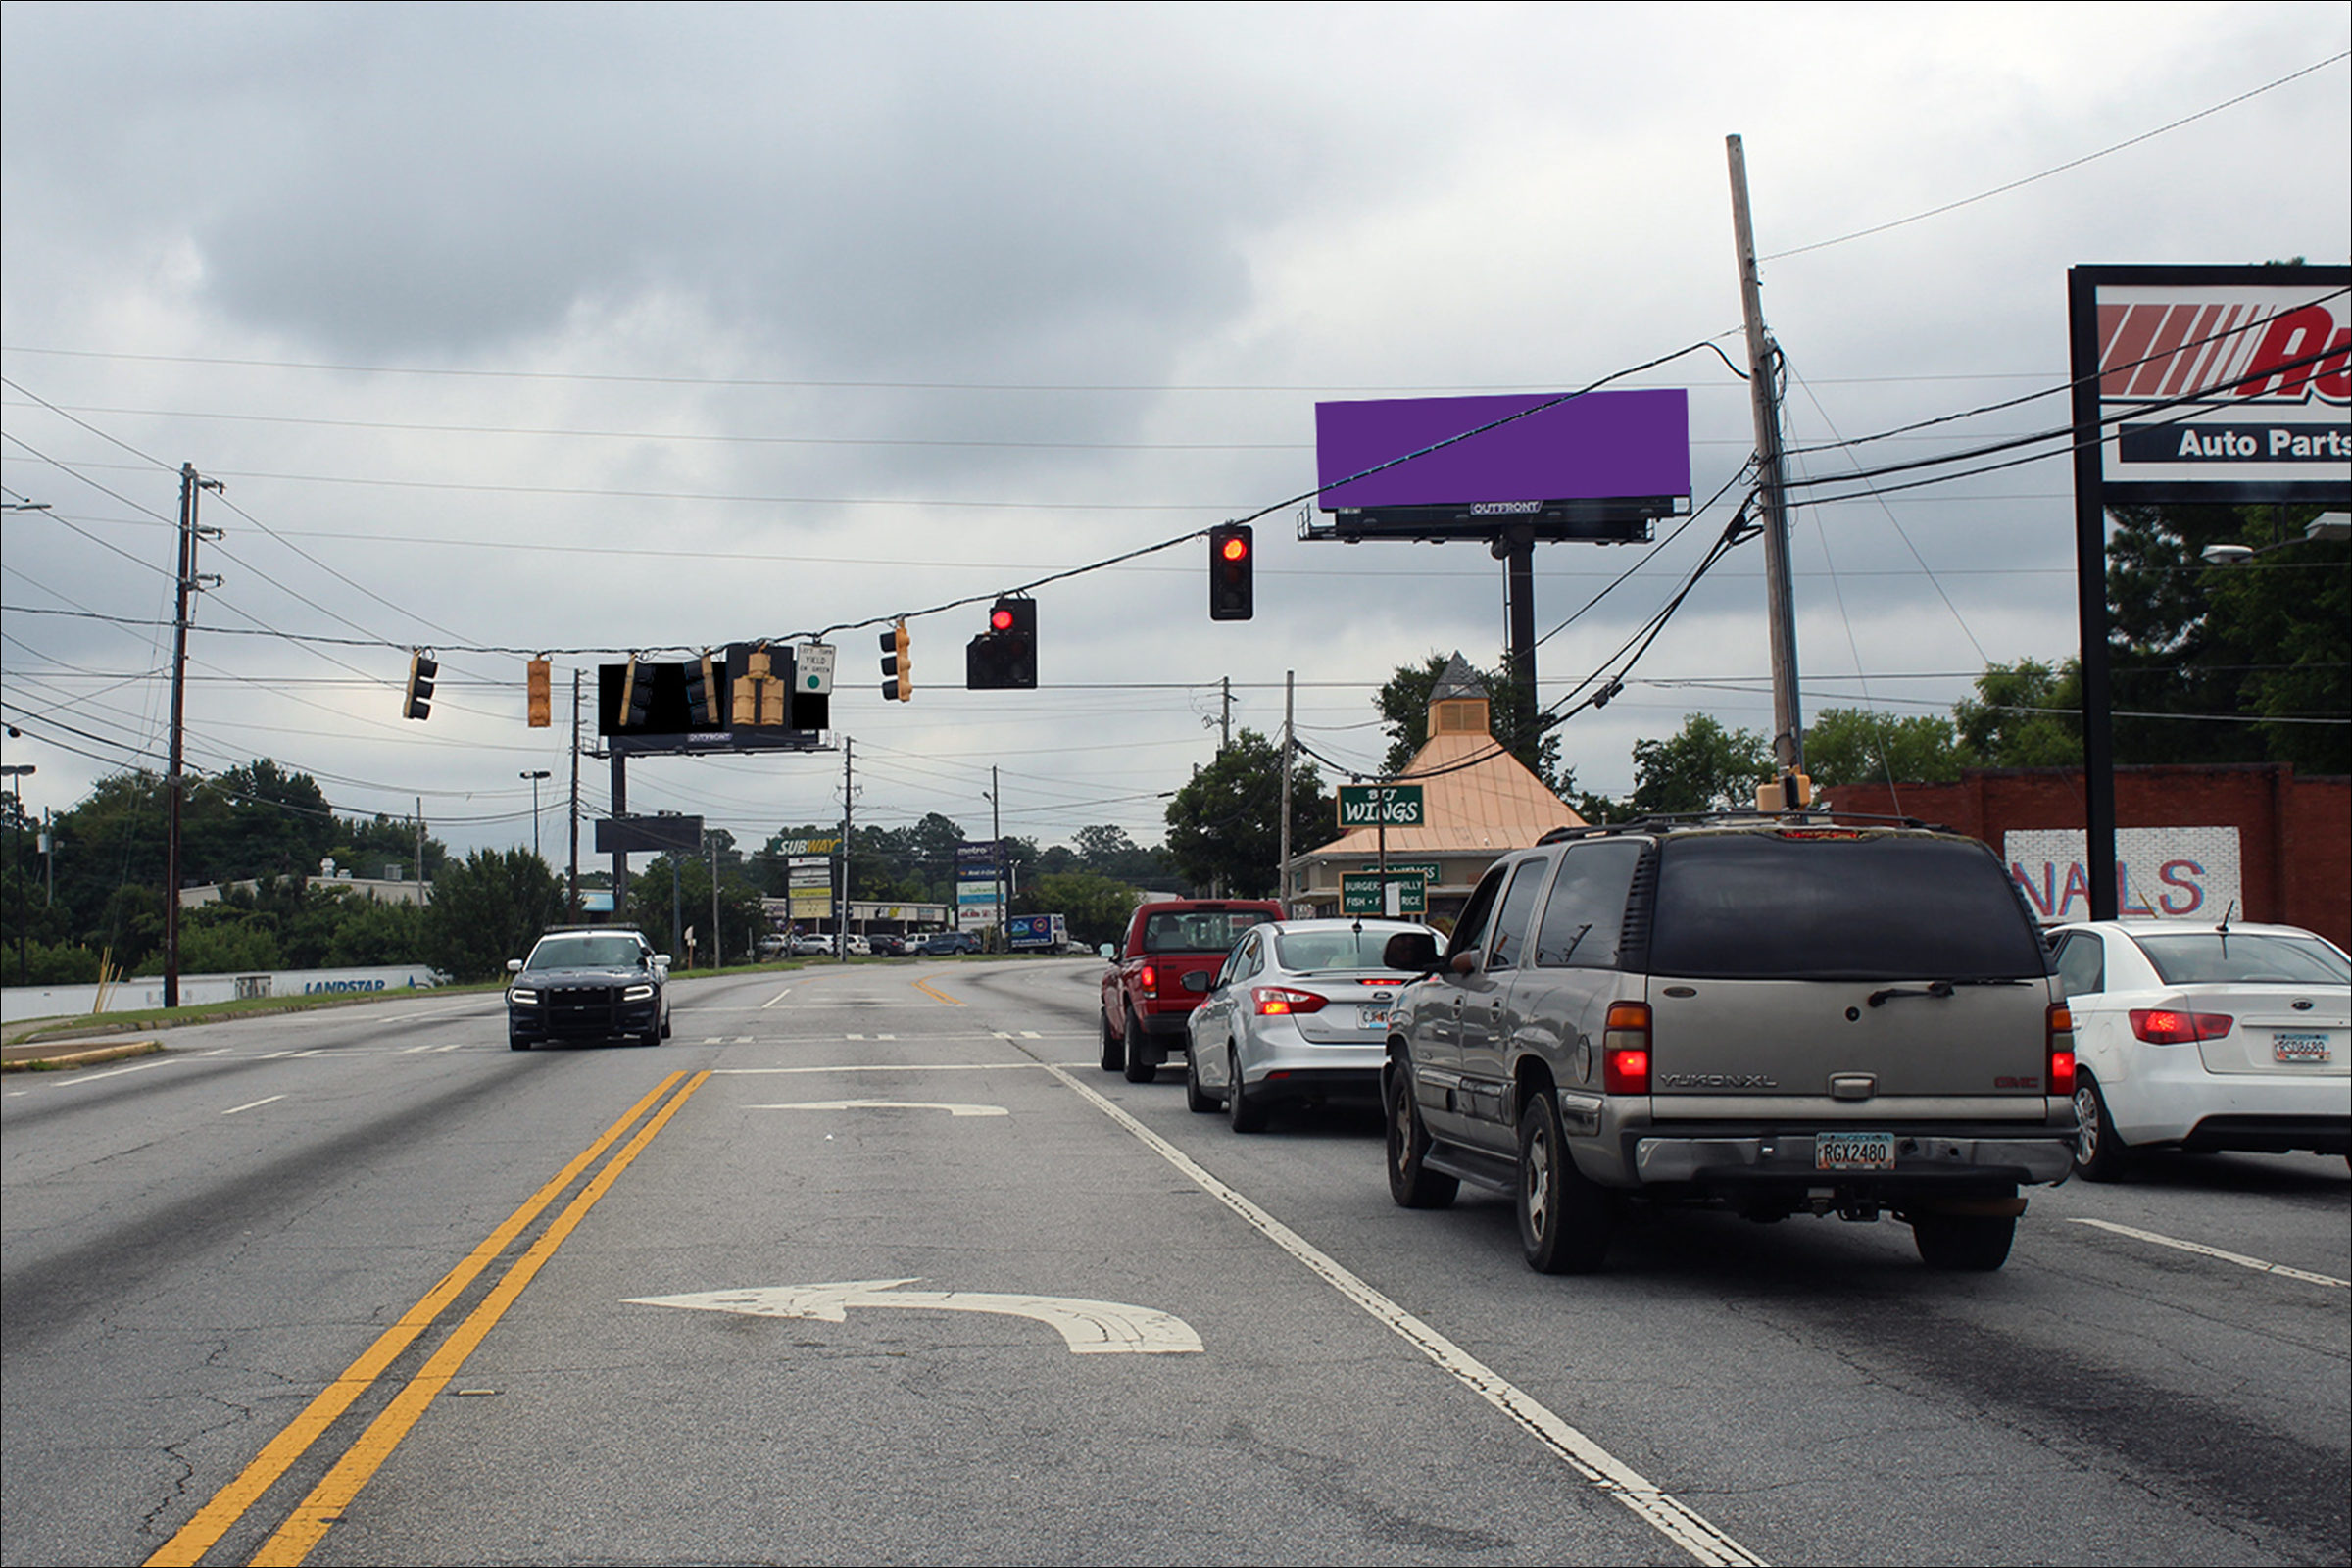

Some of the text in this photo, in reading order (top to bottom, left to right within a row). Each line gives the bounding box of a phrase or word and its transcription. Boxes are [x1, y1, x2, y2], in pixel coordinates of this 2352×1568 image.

[2177, 428, 2351, 457] Auto Parts
[1473, 501, 1540, 514] OUTFRONT
[805, 656, 826, 665] YIELD
[1345, 801, 1418, 822] WINGS
[776, 838, 843, 856] SUBWAY
[1397, 880, 1423, 891] HILLY
[2011, 858, 2205, 916] NALS
[1346, 896, 1366, 906] FISH
[1400, 895, 1421, 906] RICE
[304, 979, 385, 996] LANDSTAR
[1660, 1073, 1780, 1088] YUKON XL
[1994, 1076, 2039, 1088] GMC
[1823, 1143, 1887, 1163] RGX2480
